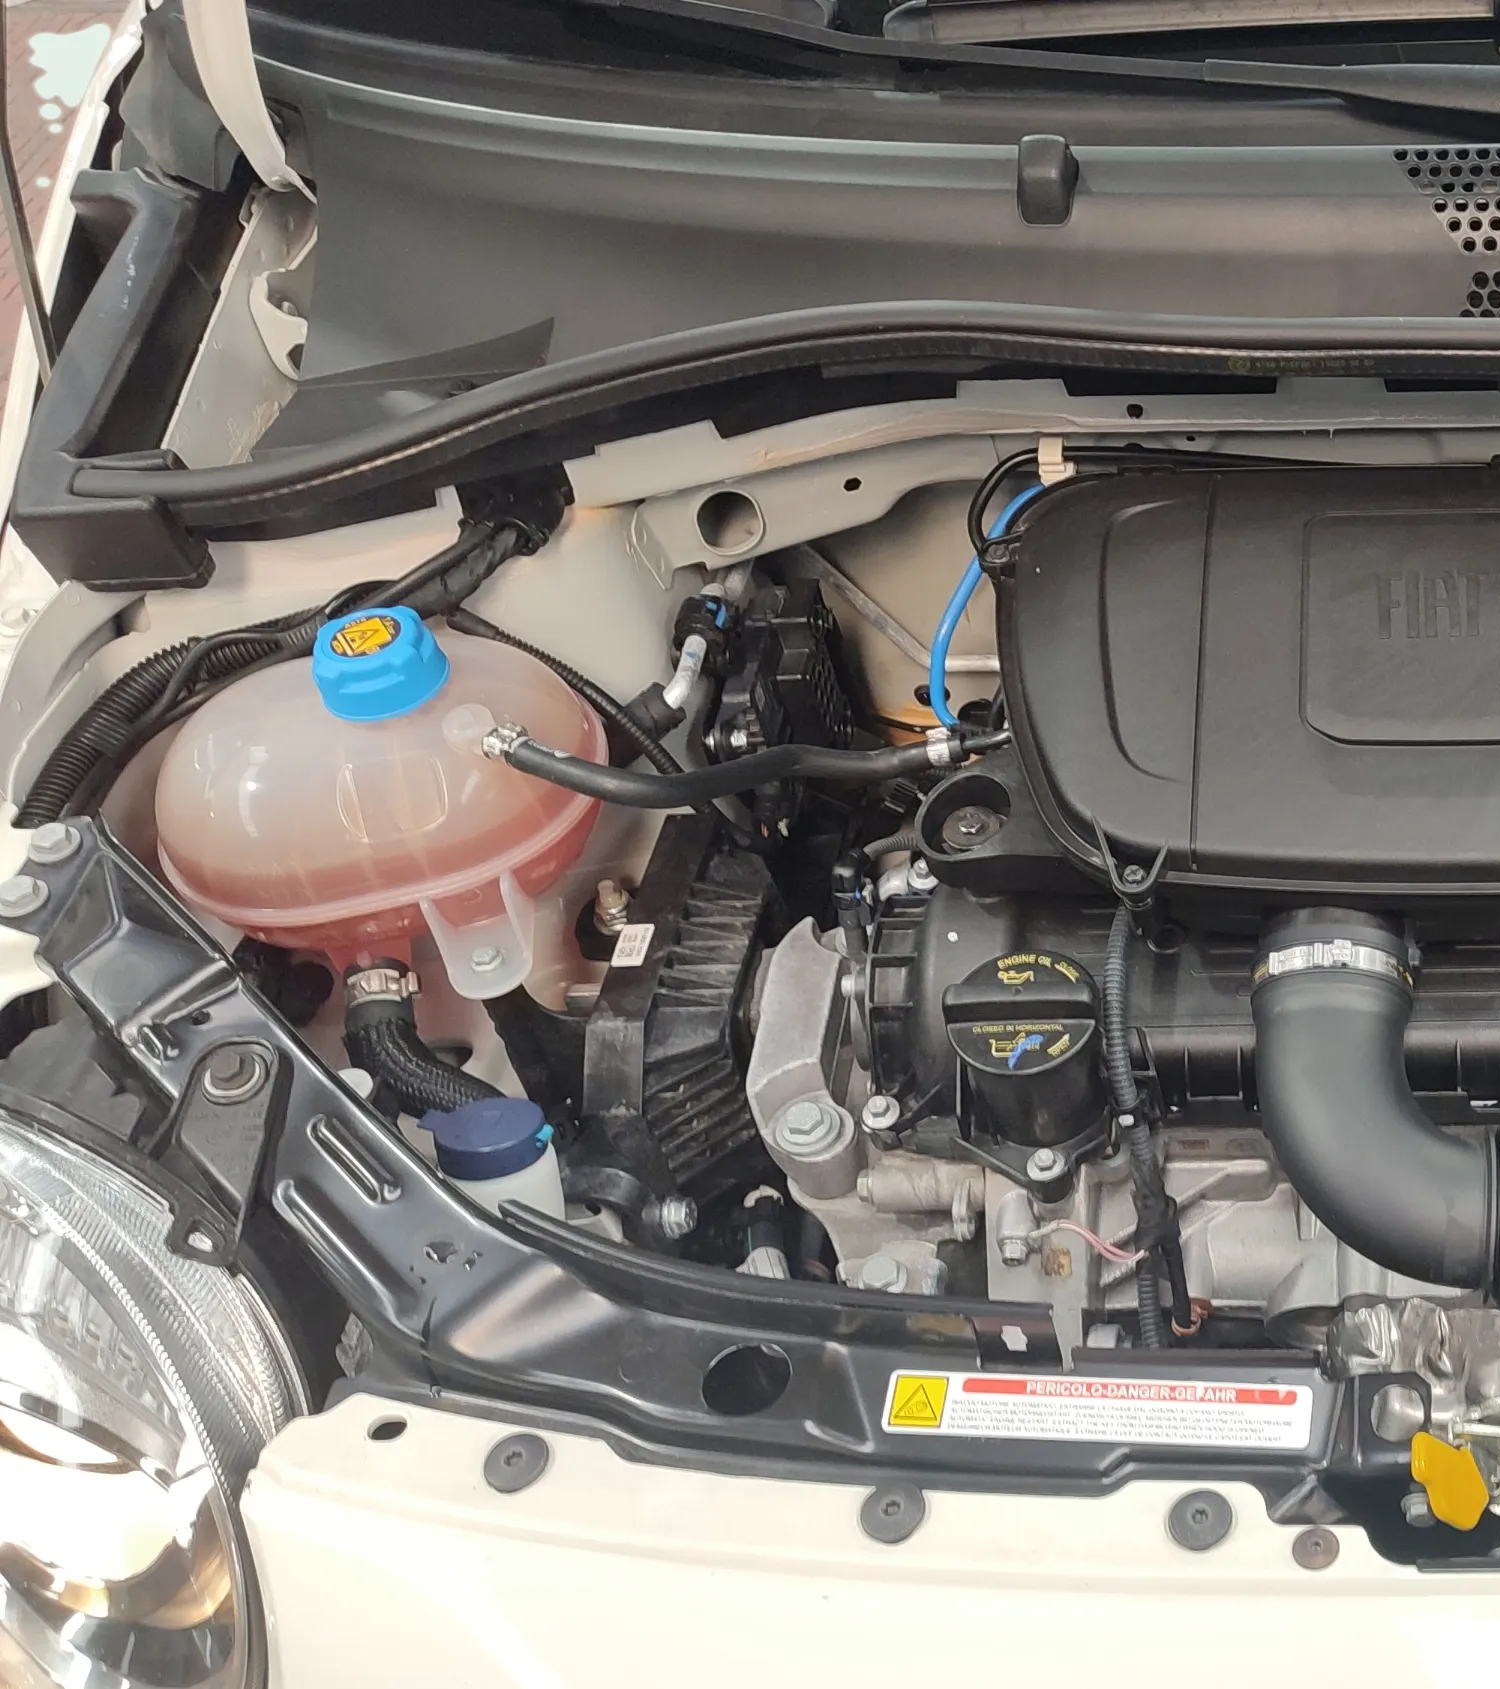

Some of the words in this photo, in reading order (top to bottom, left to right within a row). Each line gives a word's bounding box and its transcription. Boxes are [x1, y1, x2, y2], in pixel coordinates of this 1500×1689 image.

[1374, 571, 1490, 640] FIAT
[996, 953, 1037, 970] ENGINE
[1037, 955, 1053, 969] OIL
[1015, 1023, 1065, 1033] HORIZONTAL
